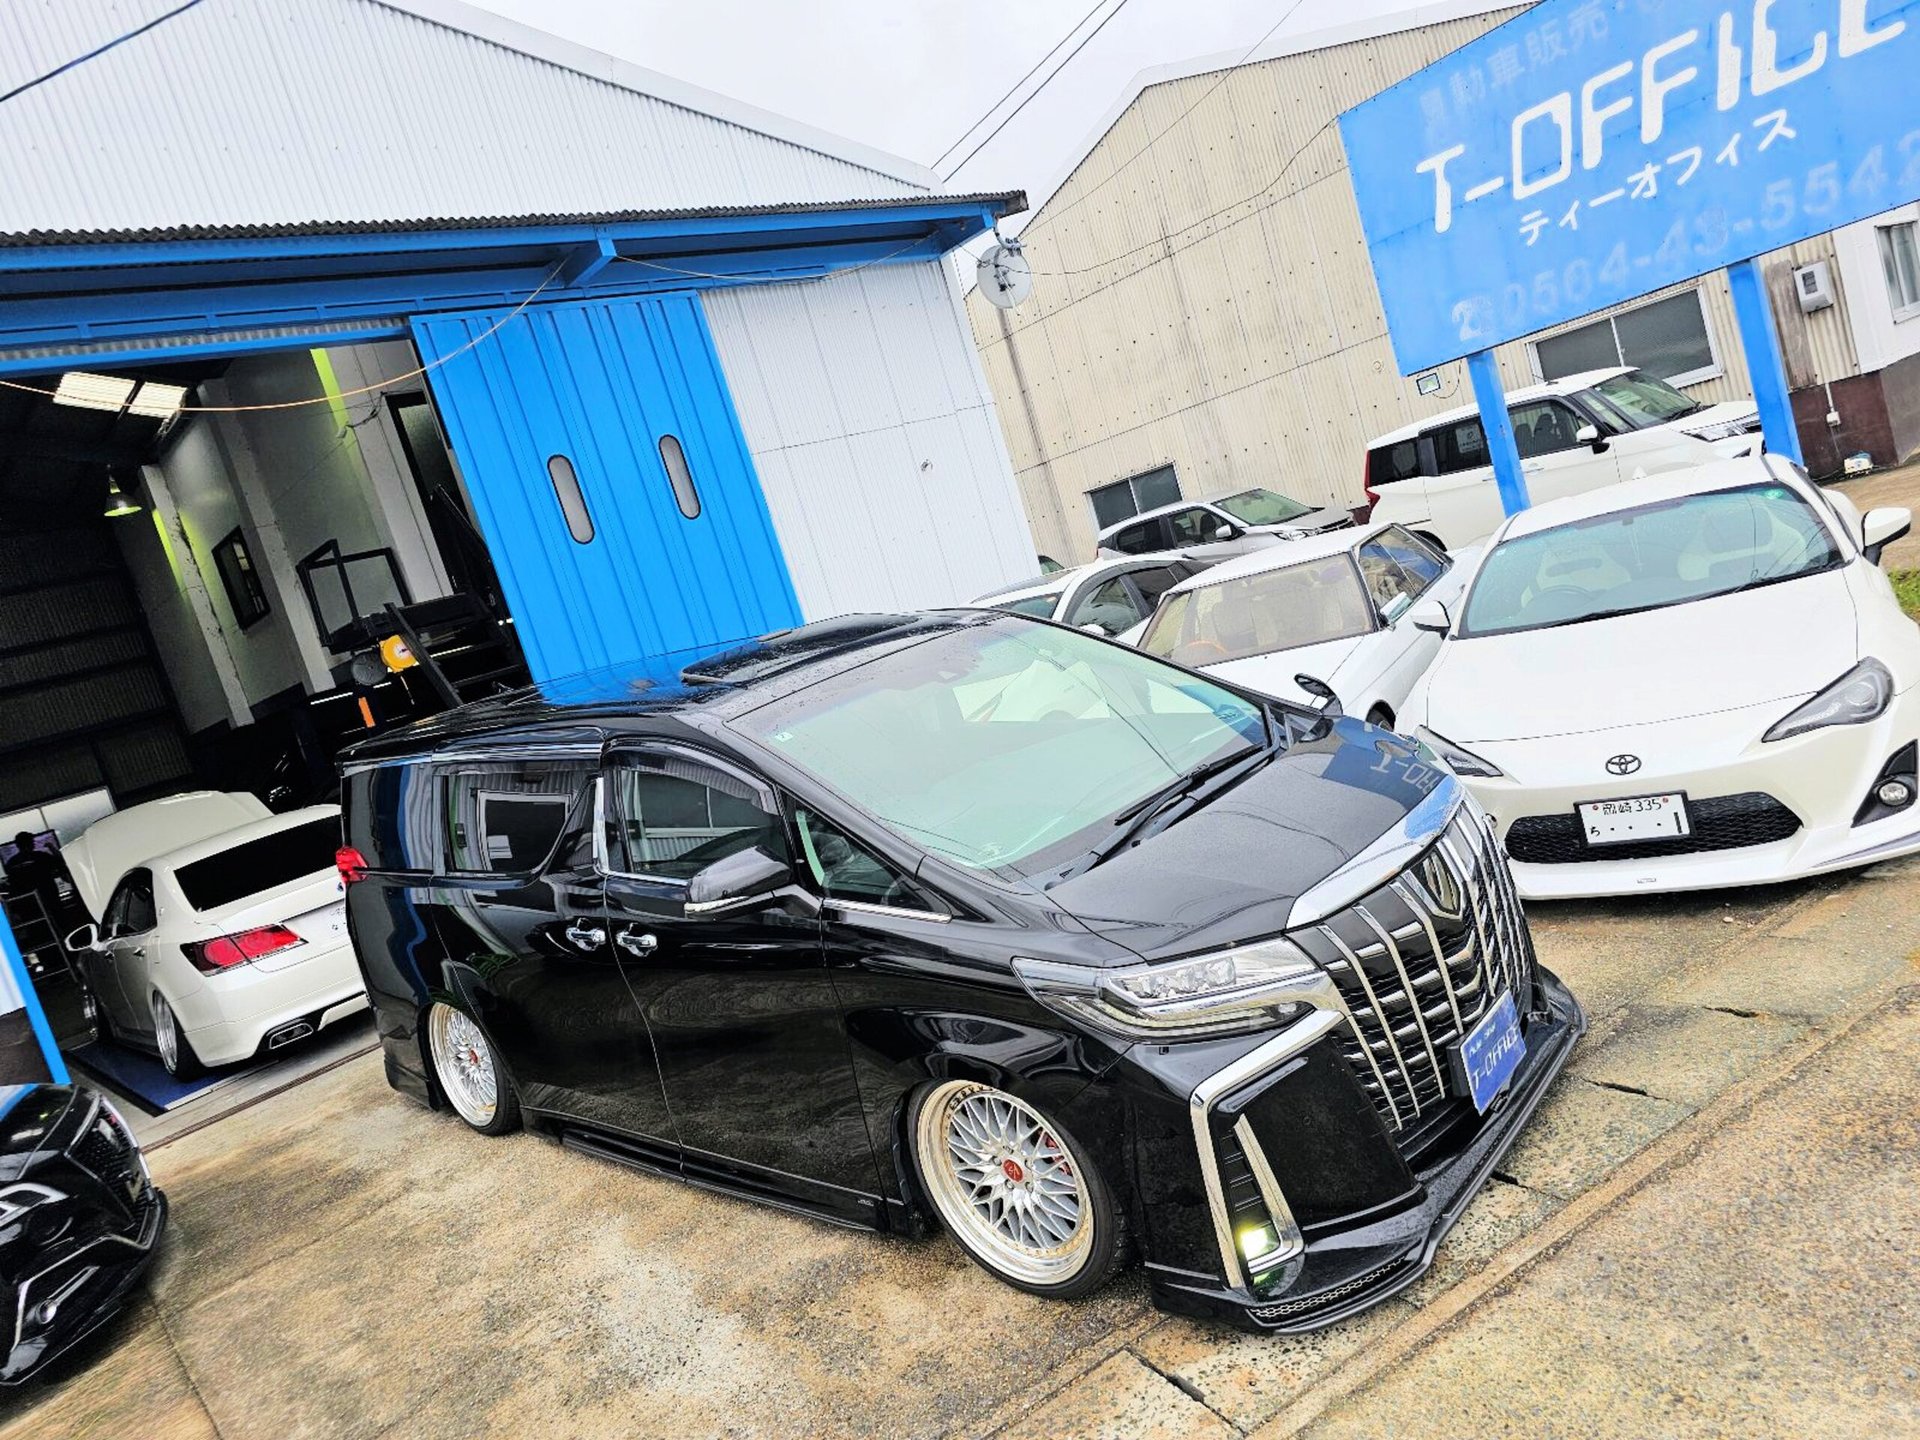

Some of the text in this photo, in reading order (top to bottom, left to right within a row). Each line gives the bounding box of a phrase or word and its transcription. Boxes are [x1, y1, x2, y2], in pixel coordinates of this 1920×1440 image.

[1519, 108, 1797, 247] ティーオフィス
[1634, 798, 1662, 812] 335
